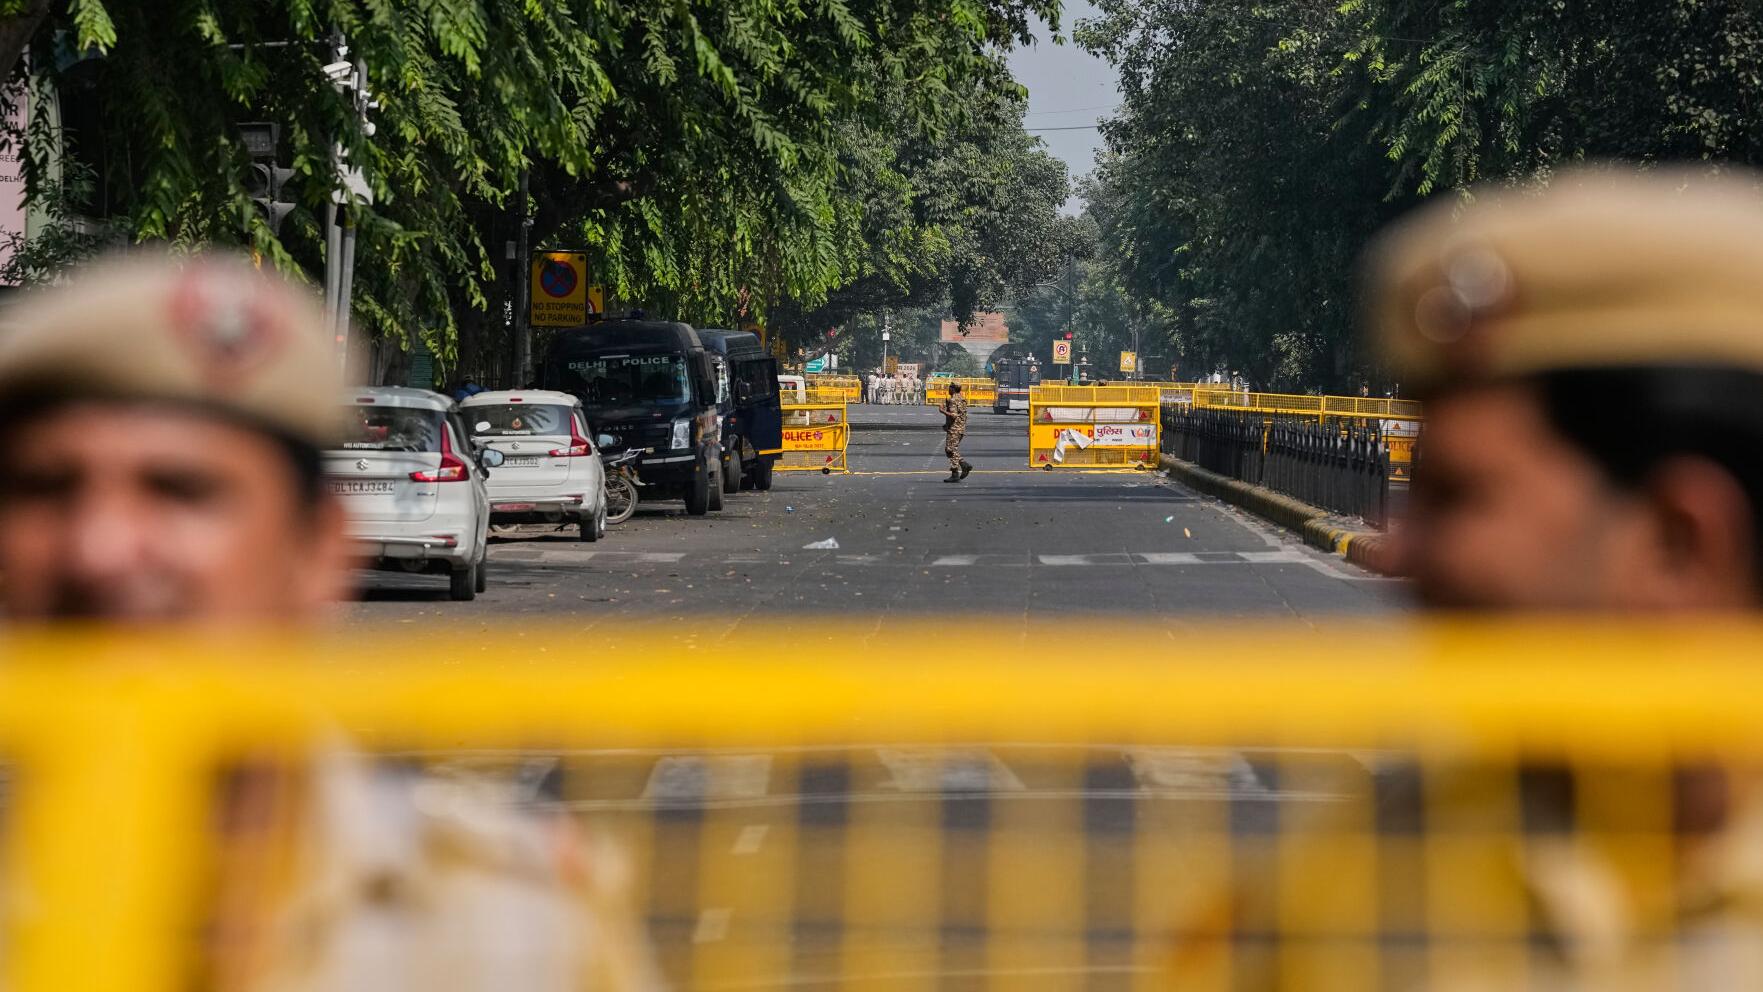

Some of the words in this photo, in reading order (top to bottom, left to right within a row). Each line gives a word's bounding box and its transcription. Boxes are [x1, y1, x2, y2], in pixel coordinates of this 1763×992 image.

[533, 302, 544, 311] NO
[546, 302, 584, 312] STOPPING
[534, 312, 546, 322] NO
[547, 312, 582, 323] PARKING
[568, 360, 607, 370] DELHI
[622, 356, 670, 366] POLICE
[1096, 425, 1123, 437] पुलिस
